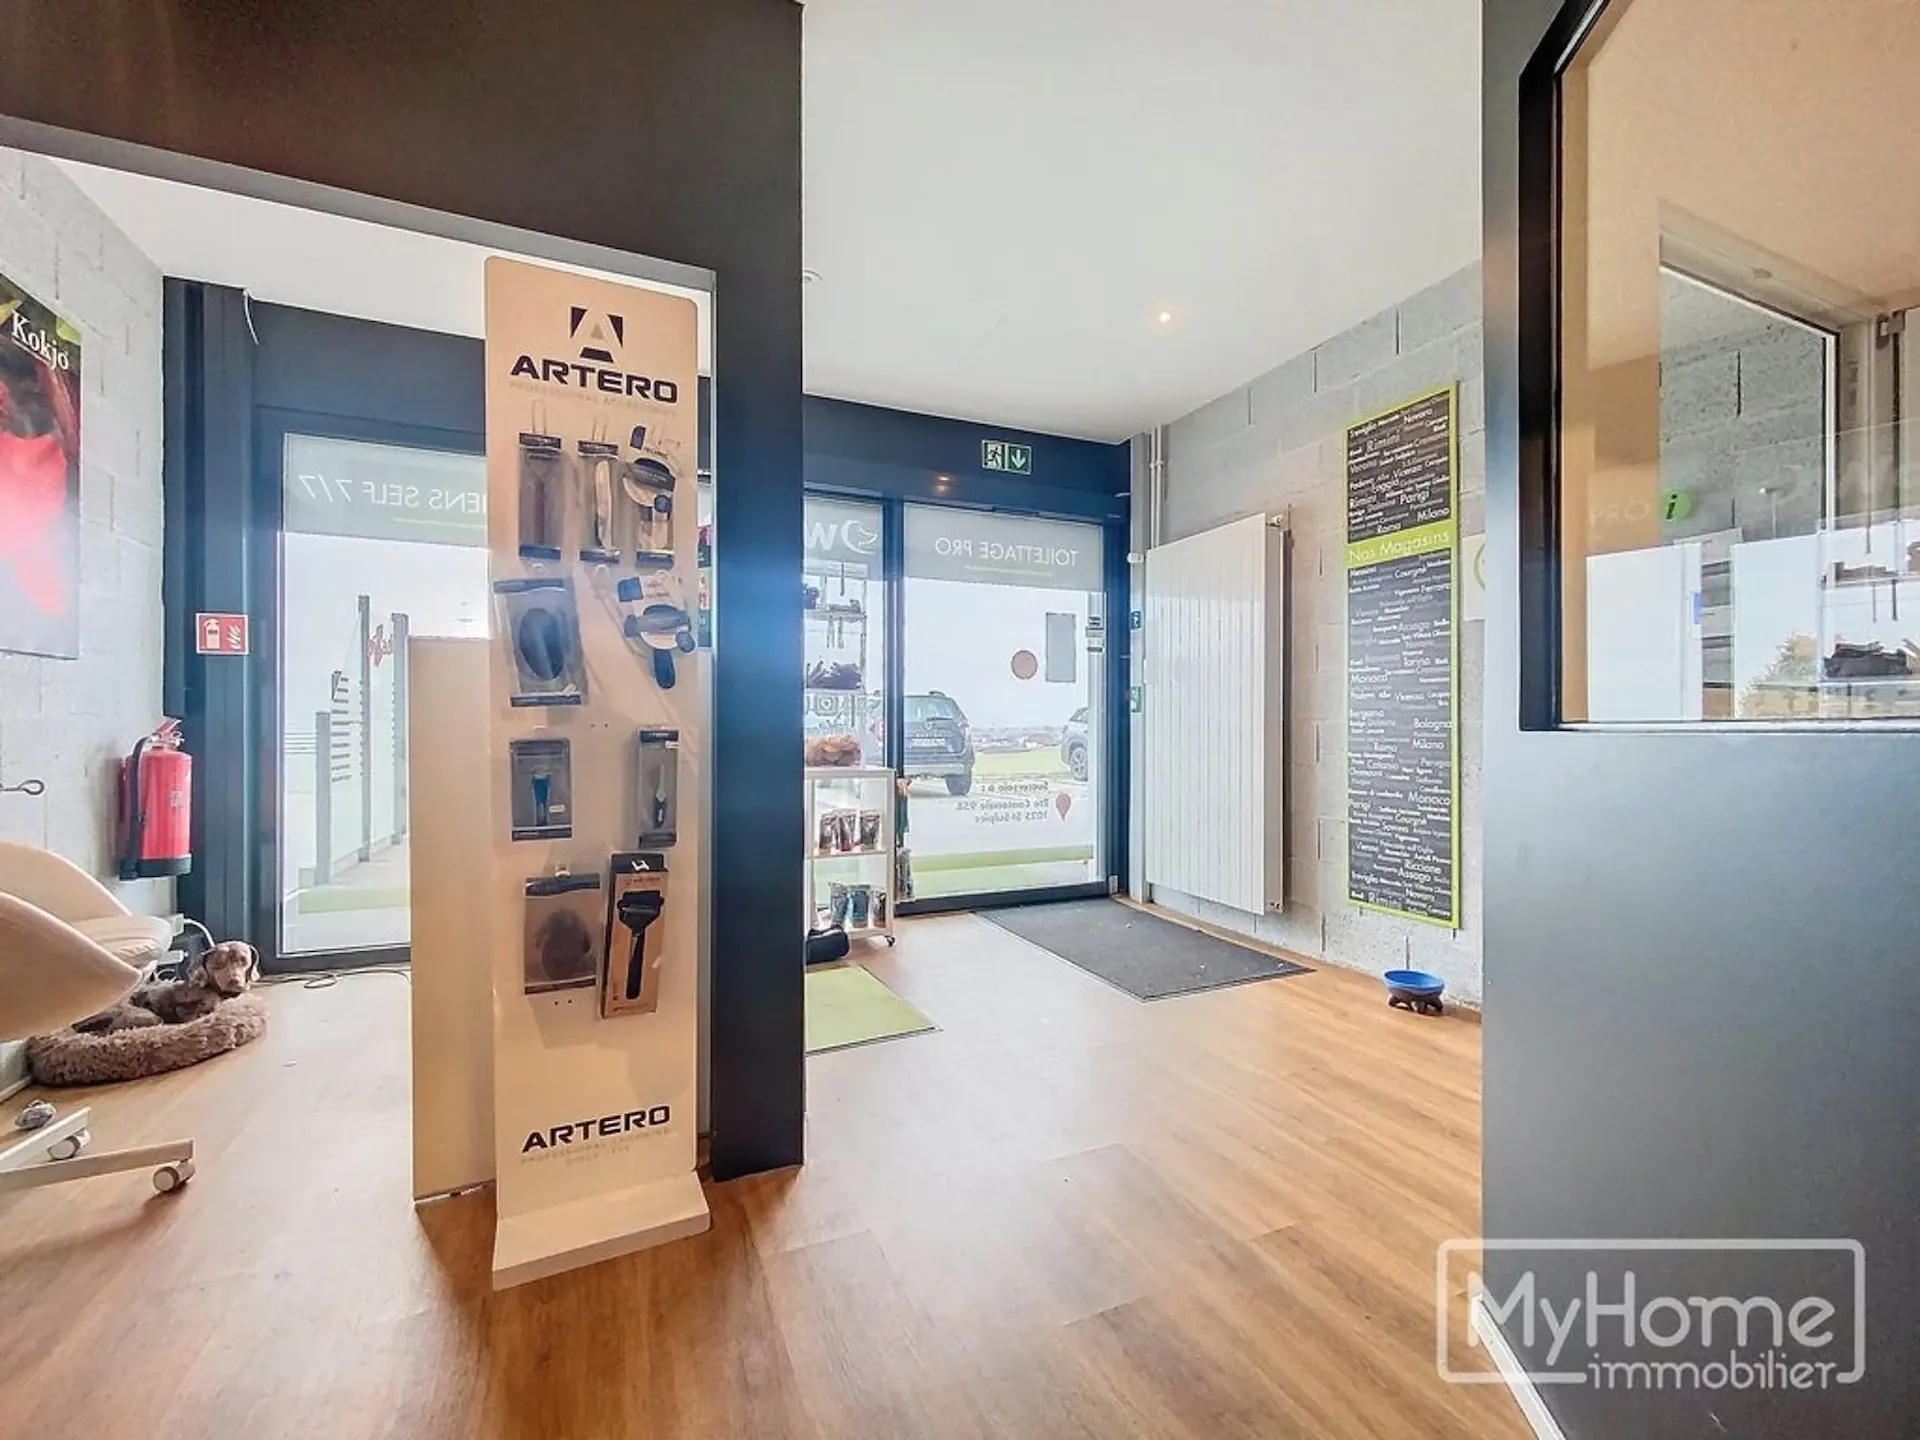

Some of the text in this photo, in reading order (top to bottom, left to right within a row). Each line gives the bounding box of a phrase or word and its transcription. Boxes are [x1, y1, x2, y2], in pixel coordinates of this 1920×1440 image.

[12, 309, 69, 371] Kokjo
[510, 354, 678, 404] ARTERO
[1417, 507, 1450, 522] Milano
[1349, 532, 1449, 563] Nos Magasins
[1351, 674, 1388, 685] Monaco
[1413, 717, 1452, 732] Bologna
[1412, 738, 1445, 750] Milano
[1408, 791, 1450, 806] Monaco
[521, 1105, 670, 1154] ARTERO
